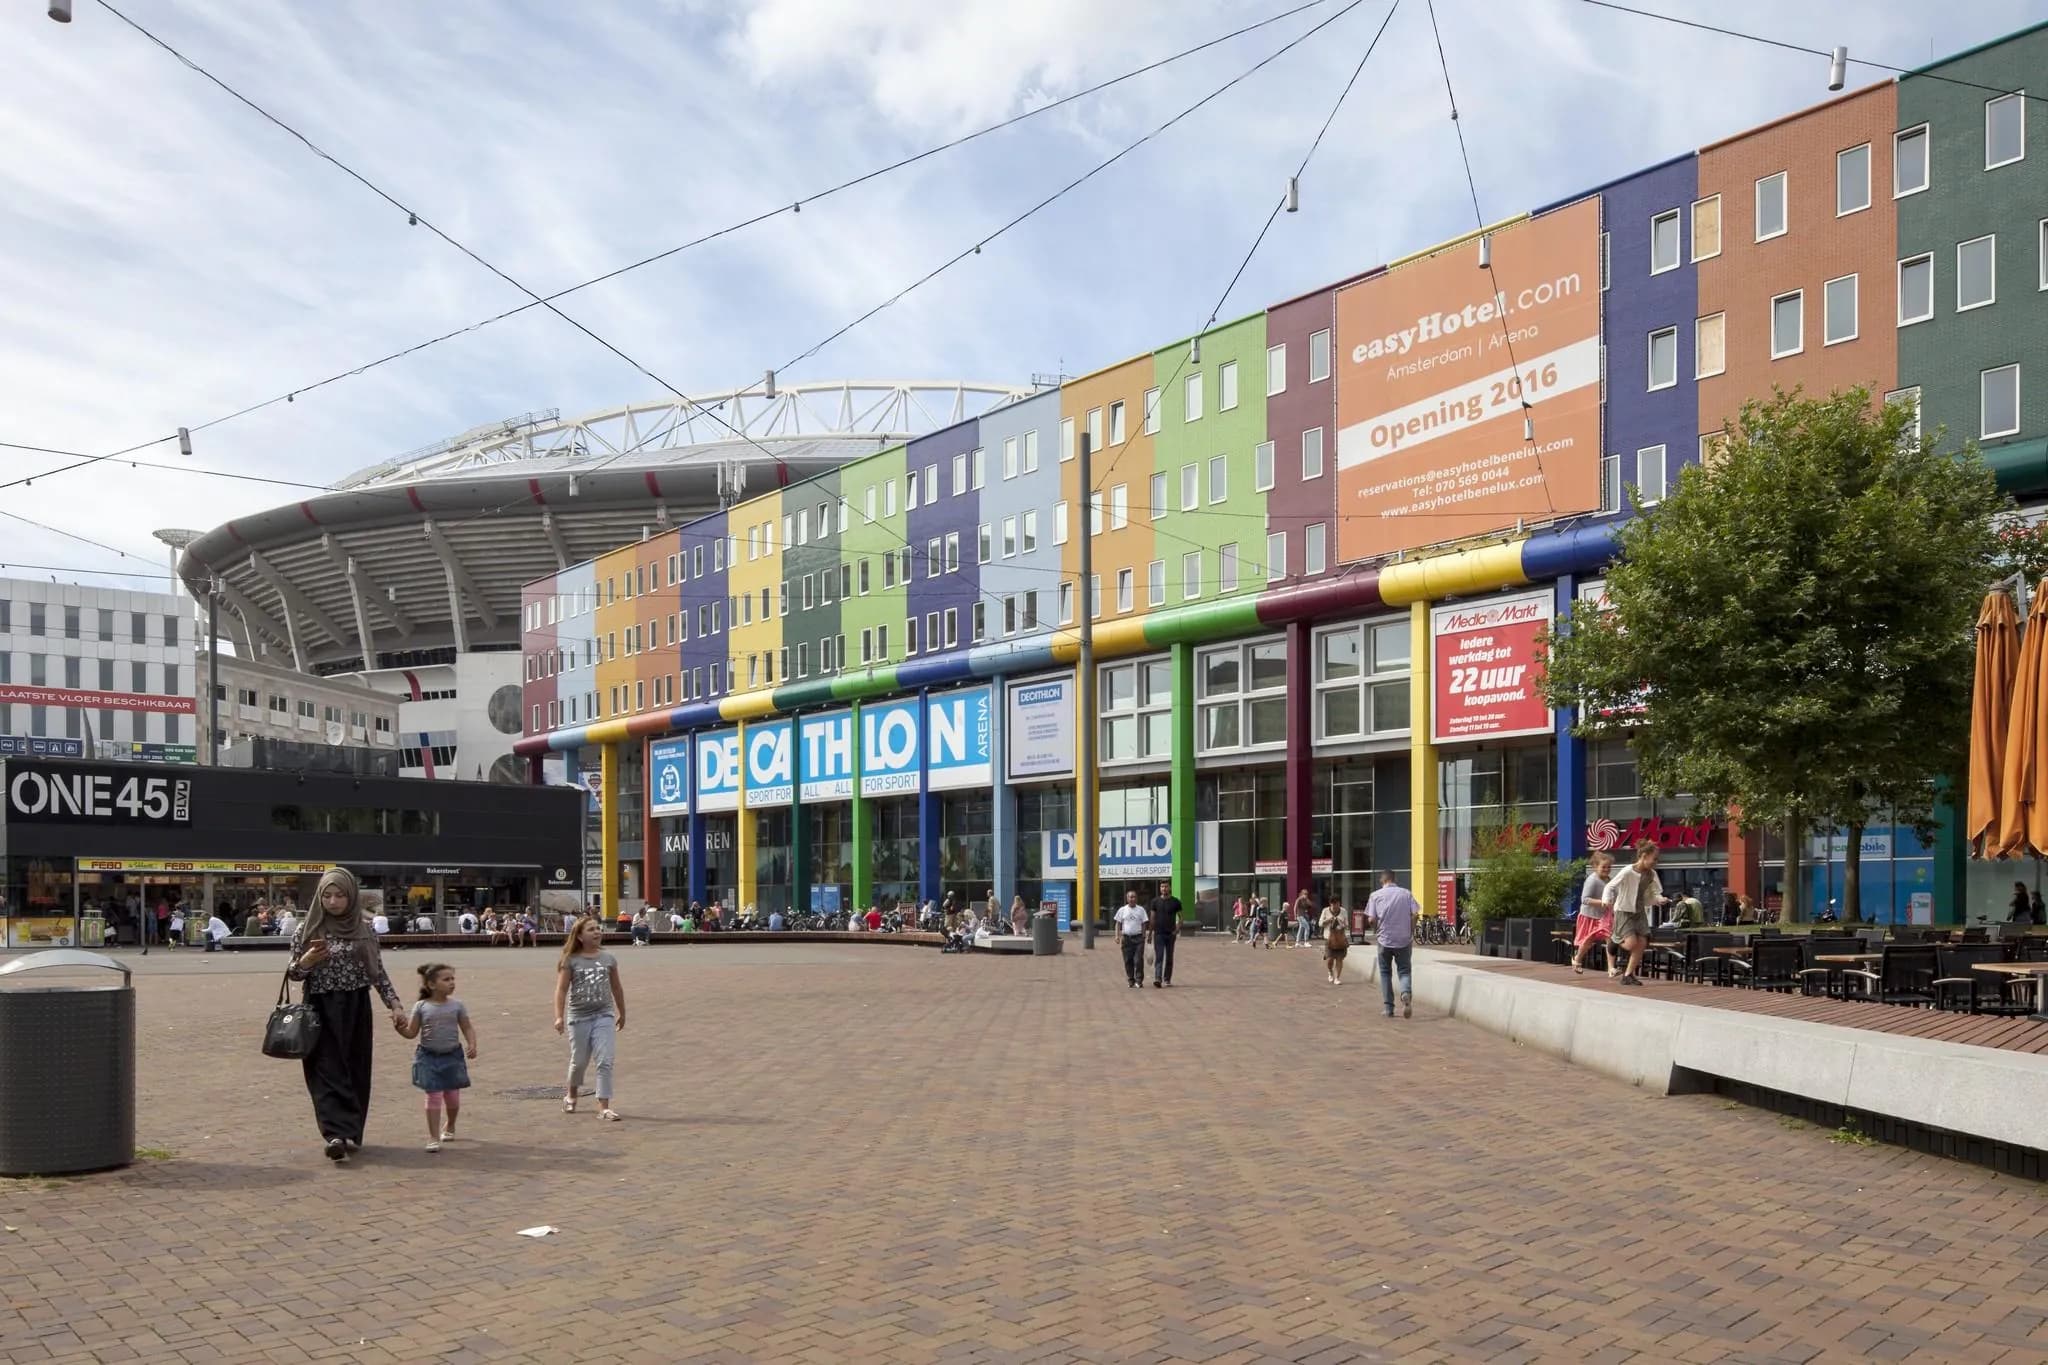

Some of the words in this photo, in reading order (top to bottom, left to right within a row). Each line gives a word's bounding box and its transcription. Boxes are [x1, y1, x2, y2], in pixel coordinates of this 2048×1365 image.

[1352, 272, 1580, 363] easyHotel.com
[1387, 344, 1472, 382] Amsterdam
[1488, 325, 1539, 350] Arena
[1370, 394, 1482, 450] Opening
[1490, 362, 1558, 407] 2016
[1358, 437, 1574, 498] reservations@easyhotelbenelux.com
[1412, 486, 1433, 498] Tel:
[1435, 480, 1456, 493] 070
[1458, 473, 1479, 487] 569
[1482, 466, 1510, 481] 0044
[1381, 474, 1545, 519] www.easyhotelbenelux.com
[1444, 613, 1487, 631] Media
[1497, 604, 1538, 622] Markt
[1448, 648, 1494, 666] werkdag
[1495, 646, 1512, 658] tot
[1460, 636, 1494, 650] Iedere
[1449, 667, 1479, 694] 22
[1480, 664, 1526, 690] uur
[1, 690, 56, 701] LAATSTE
[58, 694, 100, 704] VLOER
[104, 697, 191, 709] BESCHIKBAAR
[1464, 688, 1526, 706] koopavond.
[977, 695, 989, 757] ARENA
[174, 781, 190, 820] BLVD
[749, 789, 775, 803] SPORT
[776, 787, 792, 800] FOR
[804, 783, 819, 797] ALL
[835, 780, 850, 794] ALL
[865, 778, 883, 792] FOR
[885, 774, 916, 790] SPORT
[665, 832, 730, 852] KANREN
[91, 861, 122, 870] FEBO
[164, 862, 194, 871] FEBO
[234, 863, 262, 872] FEBO
[299, 864, 325, 872] FEBO
[1136, 866, 1149, 875] FOR
[1149, 865, 1170, 875] SPORT
